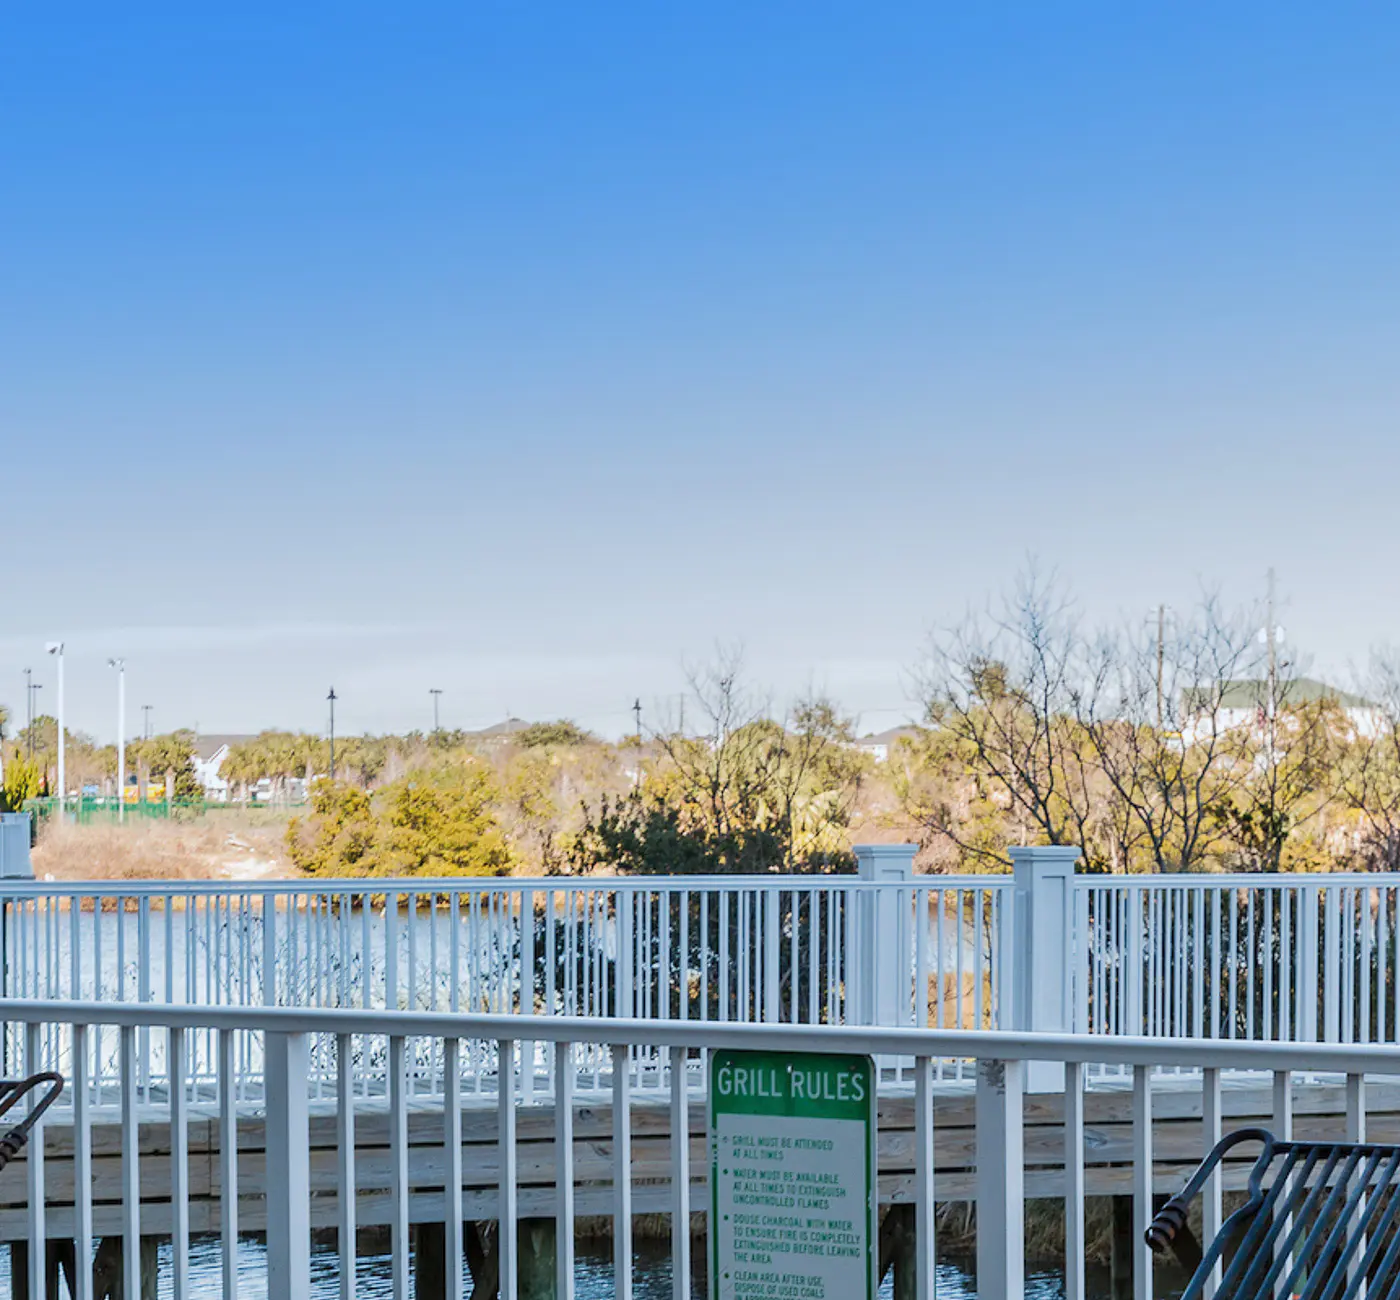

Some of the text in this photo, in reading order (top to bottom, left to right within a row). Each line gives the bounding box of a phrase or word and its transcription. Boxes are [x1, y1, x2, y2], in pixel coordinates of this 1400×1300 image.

[718, 1067, 864, 1101] GRILL RULES
[733, 1135, 833, 1150] GRILL MUST BE ATTENDED
[733, 1149, 740, 1157] AT
[744, 1149, 758, 1159] ALL
[733, 1168, 839, 1184] WATER MUST BE AVAILABLE
[733, 1182, 845, 1197] AT ALL TIMES TO EXTINGUISH
[733, 1194, 829, 1209] UNCONTROLLED FLAMES
[734, 1214, 852, 1230] DOUSE CHARCOAL WITH WATER
[734, 1226, 860, 1244] TO ENSURE FIRE IS COMPLETELY
[734, 1239, 860, 1257] EXTINGUISHED BEFORE LEAVING
[734, 1252, 747, 1262] THE
[735, 1271, 758, 1281] CLEAN
[760, 1272, 779, 1283] AREA
[782, 1274, 805, 1284] AFTER
[735, 1283, 824, 1298] DISPOSE OF USED COALS
